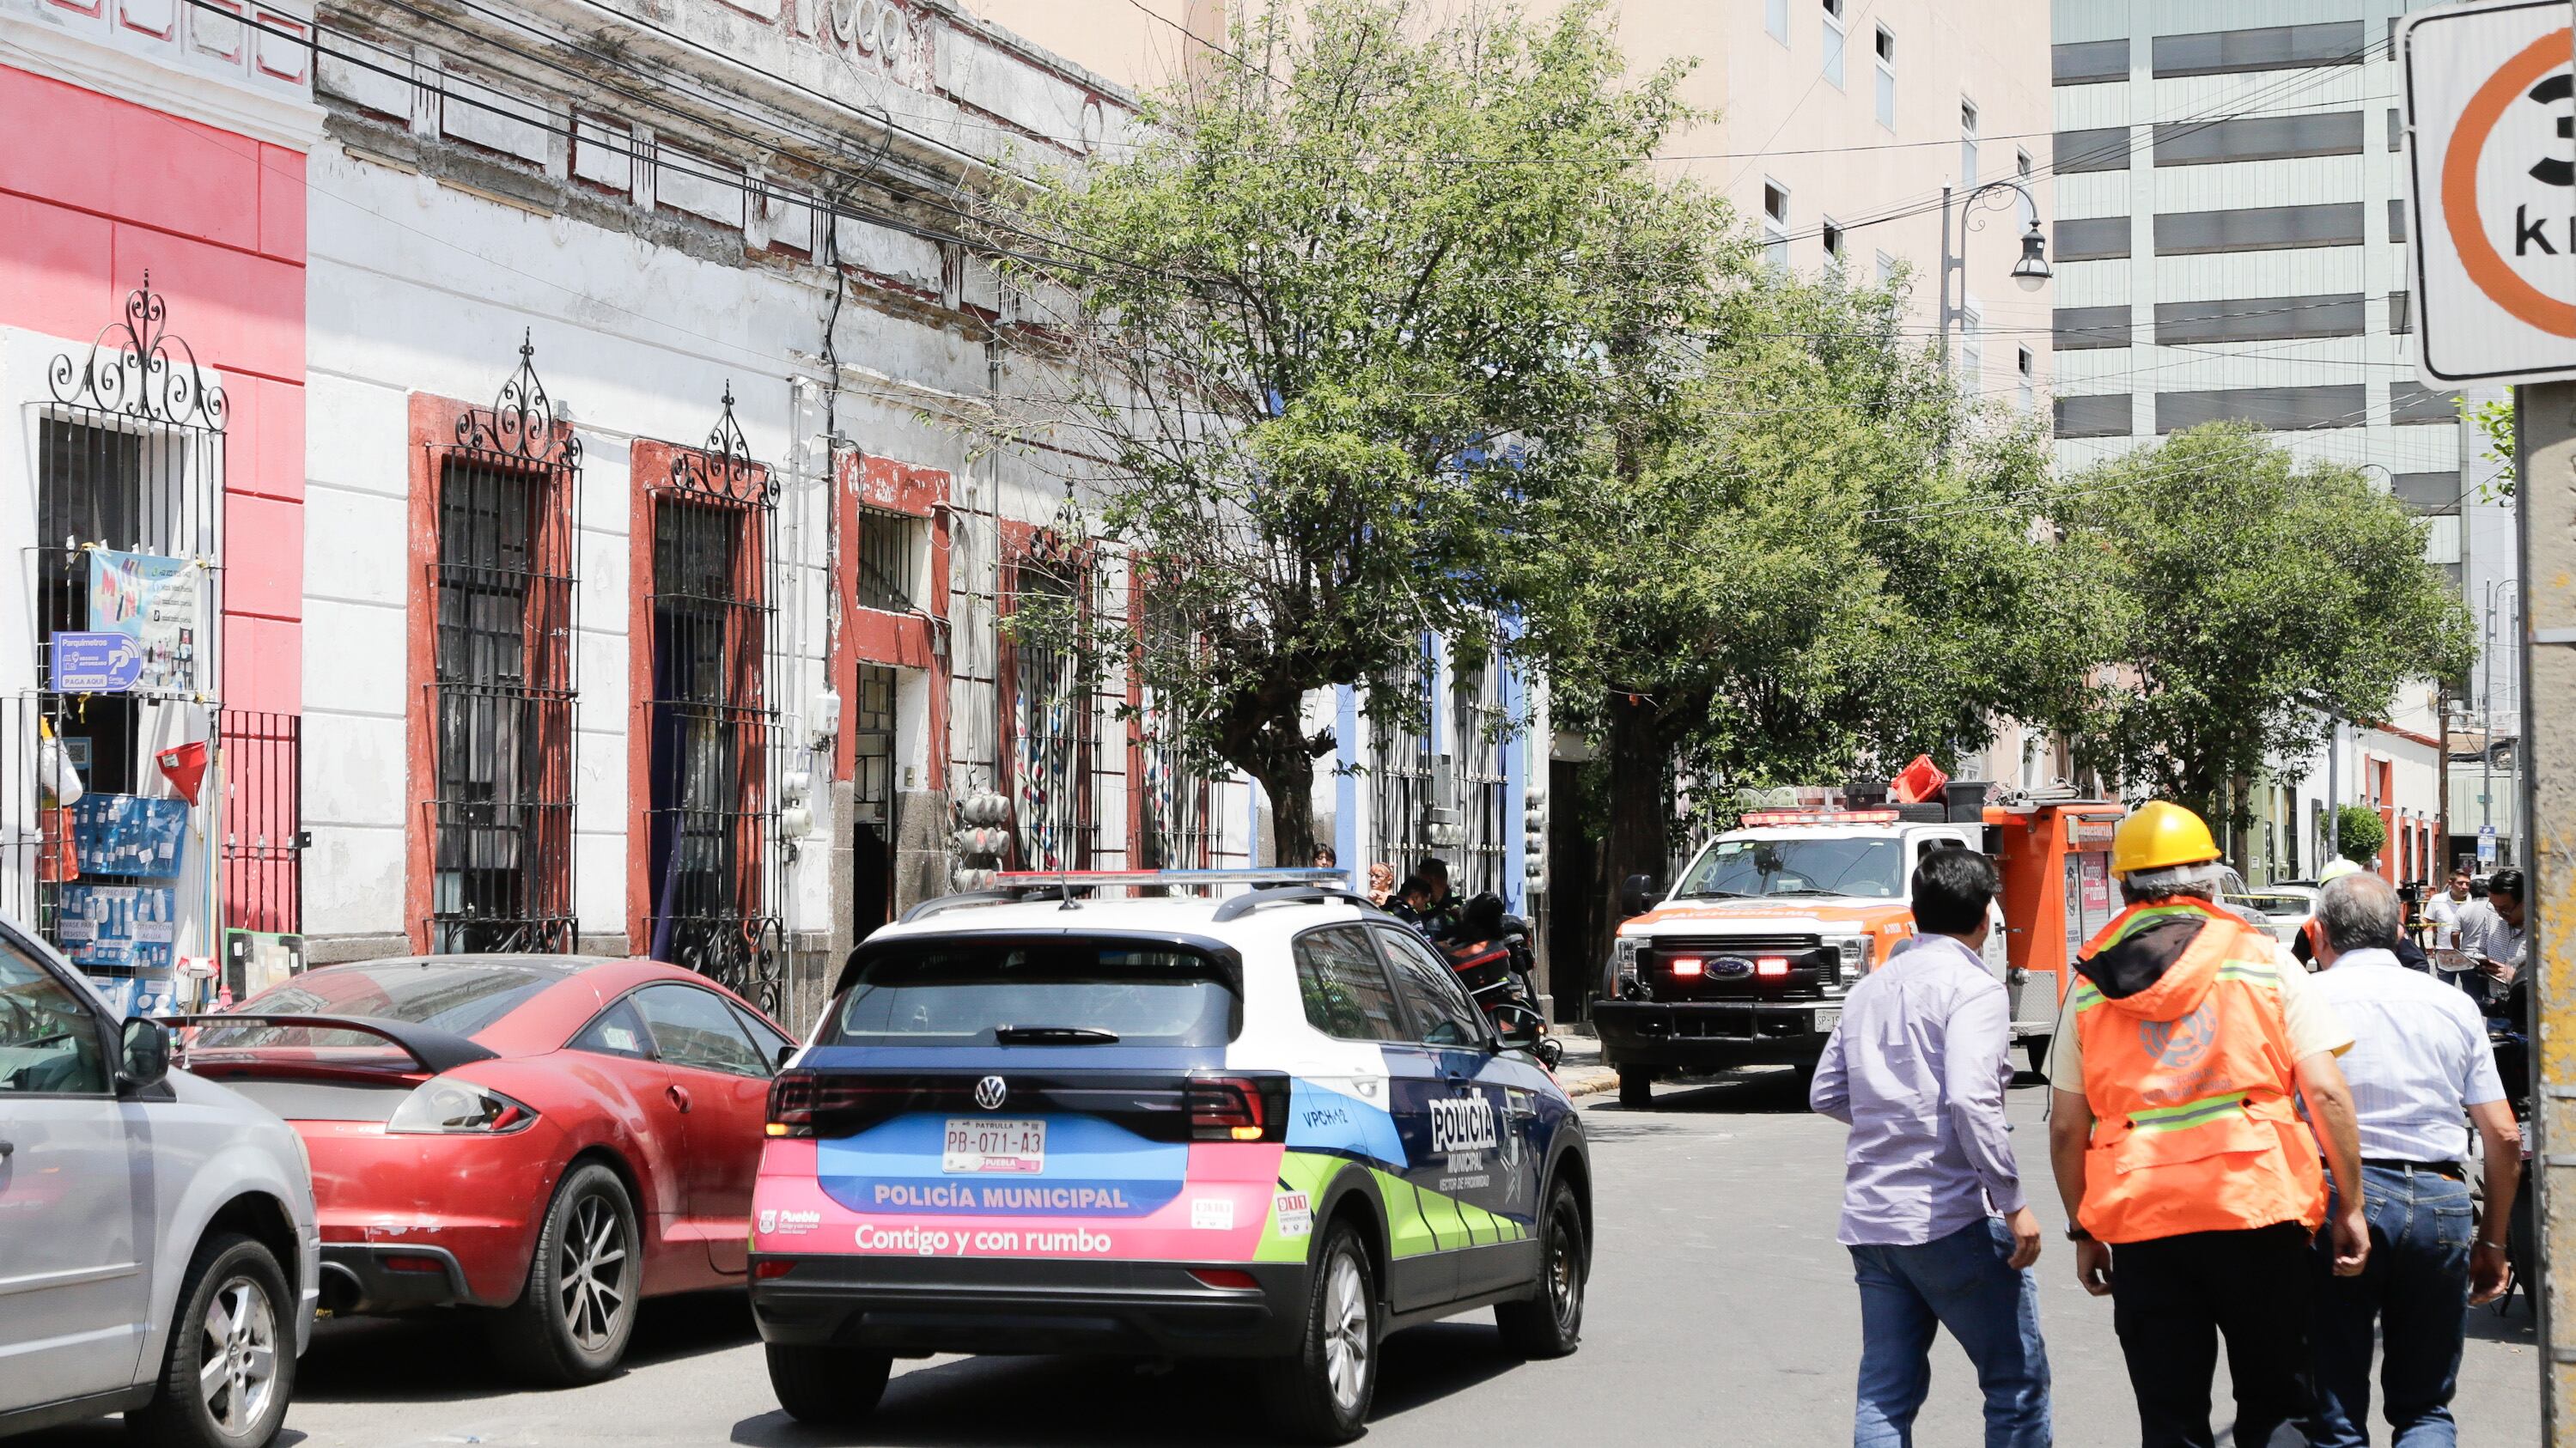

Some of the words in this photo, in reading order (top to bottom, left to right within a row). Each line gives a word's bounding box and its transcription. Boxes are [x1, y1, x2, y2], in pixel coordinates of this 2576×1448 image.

[2516, 204, 2575, 256] k
[62, 639, 107, 648] Parquímetros
[947, 1131, 1041, 1153] PB-071-A3
[985, 1158, 1016, 1167] PUEBLA
[1447, 1152, 1483, 1174] MUNICIPAL
[1458, 1177, 1464, 1190] DE
[874, 1183, 977, 1208] POLICÍA
[983, 1188, 1129, 1208] MUNICIPAL
[1278, 1196, 1306, 1212] 911
[780, 1210, 821, 1224] Puebla
[855, 1224, 949, 1256] Contigo
[953, 1231, 971, 1256] y
[975, 1231, 1018, 1251] con
[1026, 1227, 1112, 1253] rumbo
